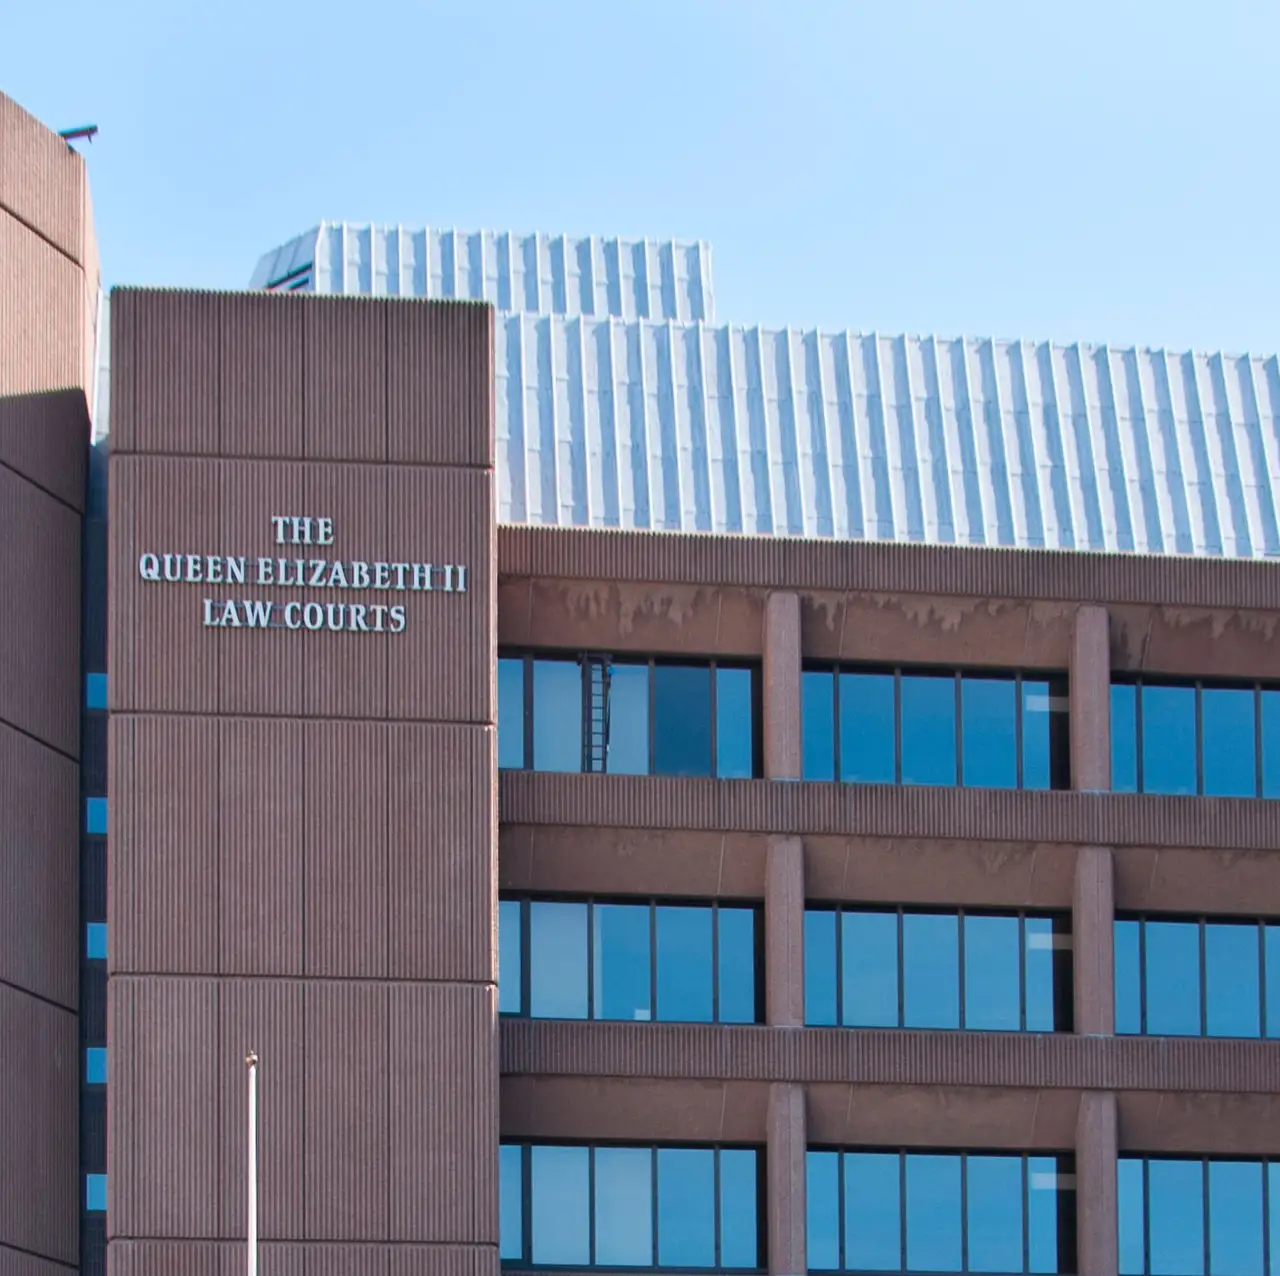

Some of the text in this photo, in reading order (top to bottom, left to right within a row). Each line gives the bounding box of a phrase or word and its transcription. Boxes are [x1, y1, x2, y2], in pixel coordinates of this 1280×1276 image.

[271, 515, 334, 546] THE
[139, 553, 467, 593] QUEEN ELIZABETH II
[203, 598, 407, 633] LAW COURTS
